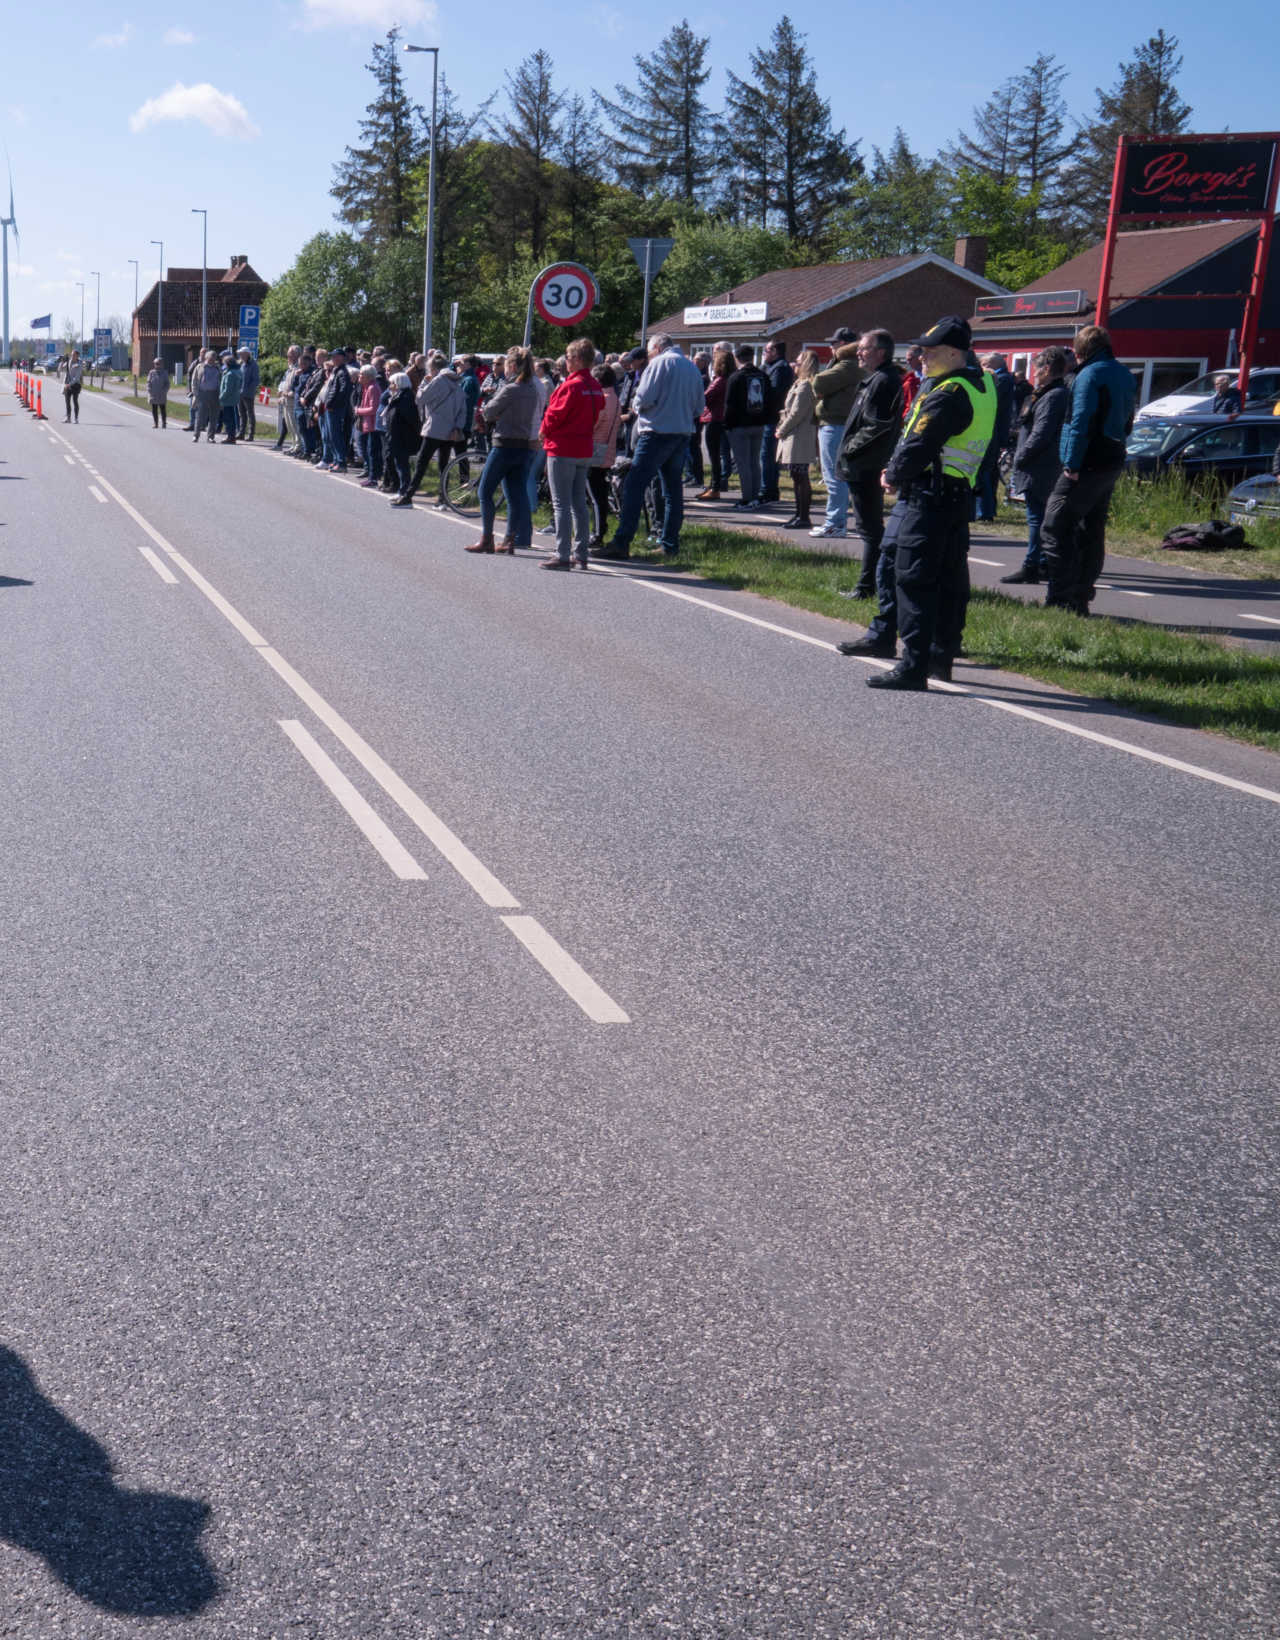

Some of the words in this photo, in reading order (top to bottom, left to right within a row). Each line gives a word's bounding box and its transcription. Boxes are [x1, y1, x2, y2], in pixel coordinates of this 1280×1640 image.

[1131, 152, 1257, 196] Borgi's
[545, 283, 584, 309] 30
[245, 308, 257, 325] P
